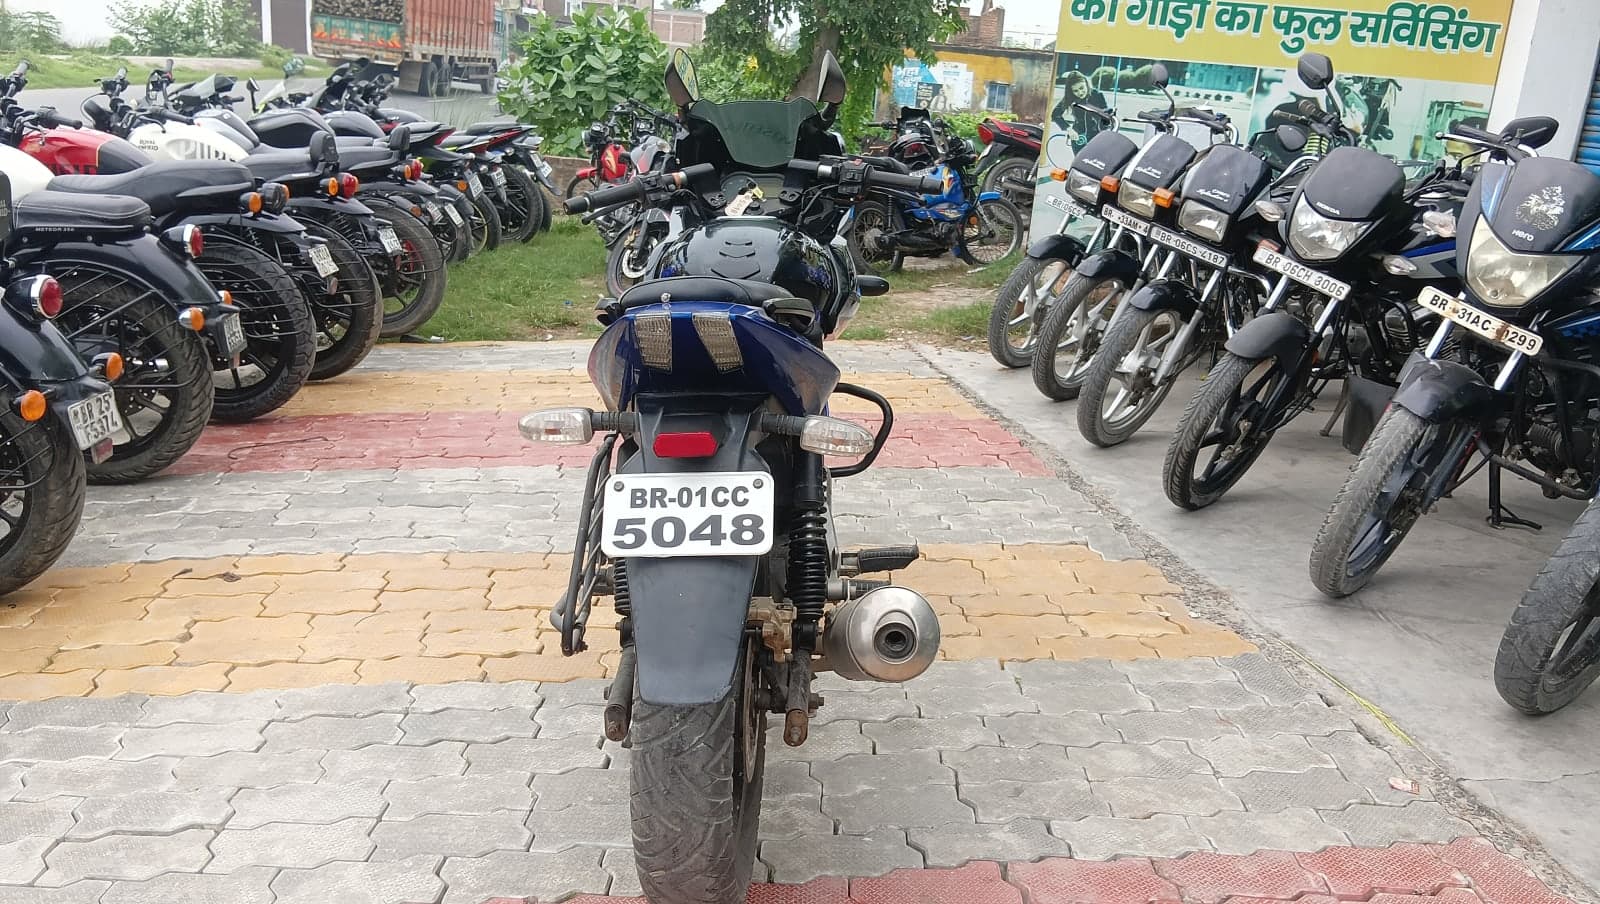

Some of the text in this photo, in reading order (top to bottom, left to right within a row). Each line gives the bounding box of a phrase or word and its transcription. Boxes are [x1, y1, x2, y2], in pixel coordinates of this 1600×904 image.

[1214, 1, 1268, 34] का
[1272, 5, 1348, 54] फुल
[1349, 2, 1502, 53] सर्विसिंग
[629, 485, 750, 509] BR-01CC
[612, 513, 765, 550] 5048
